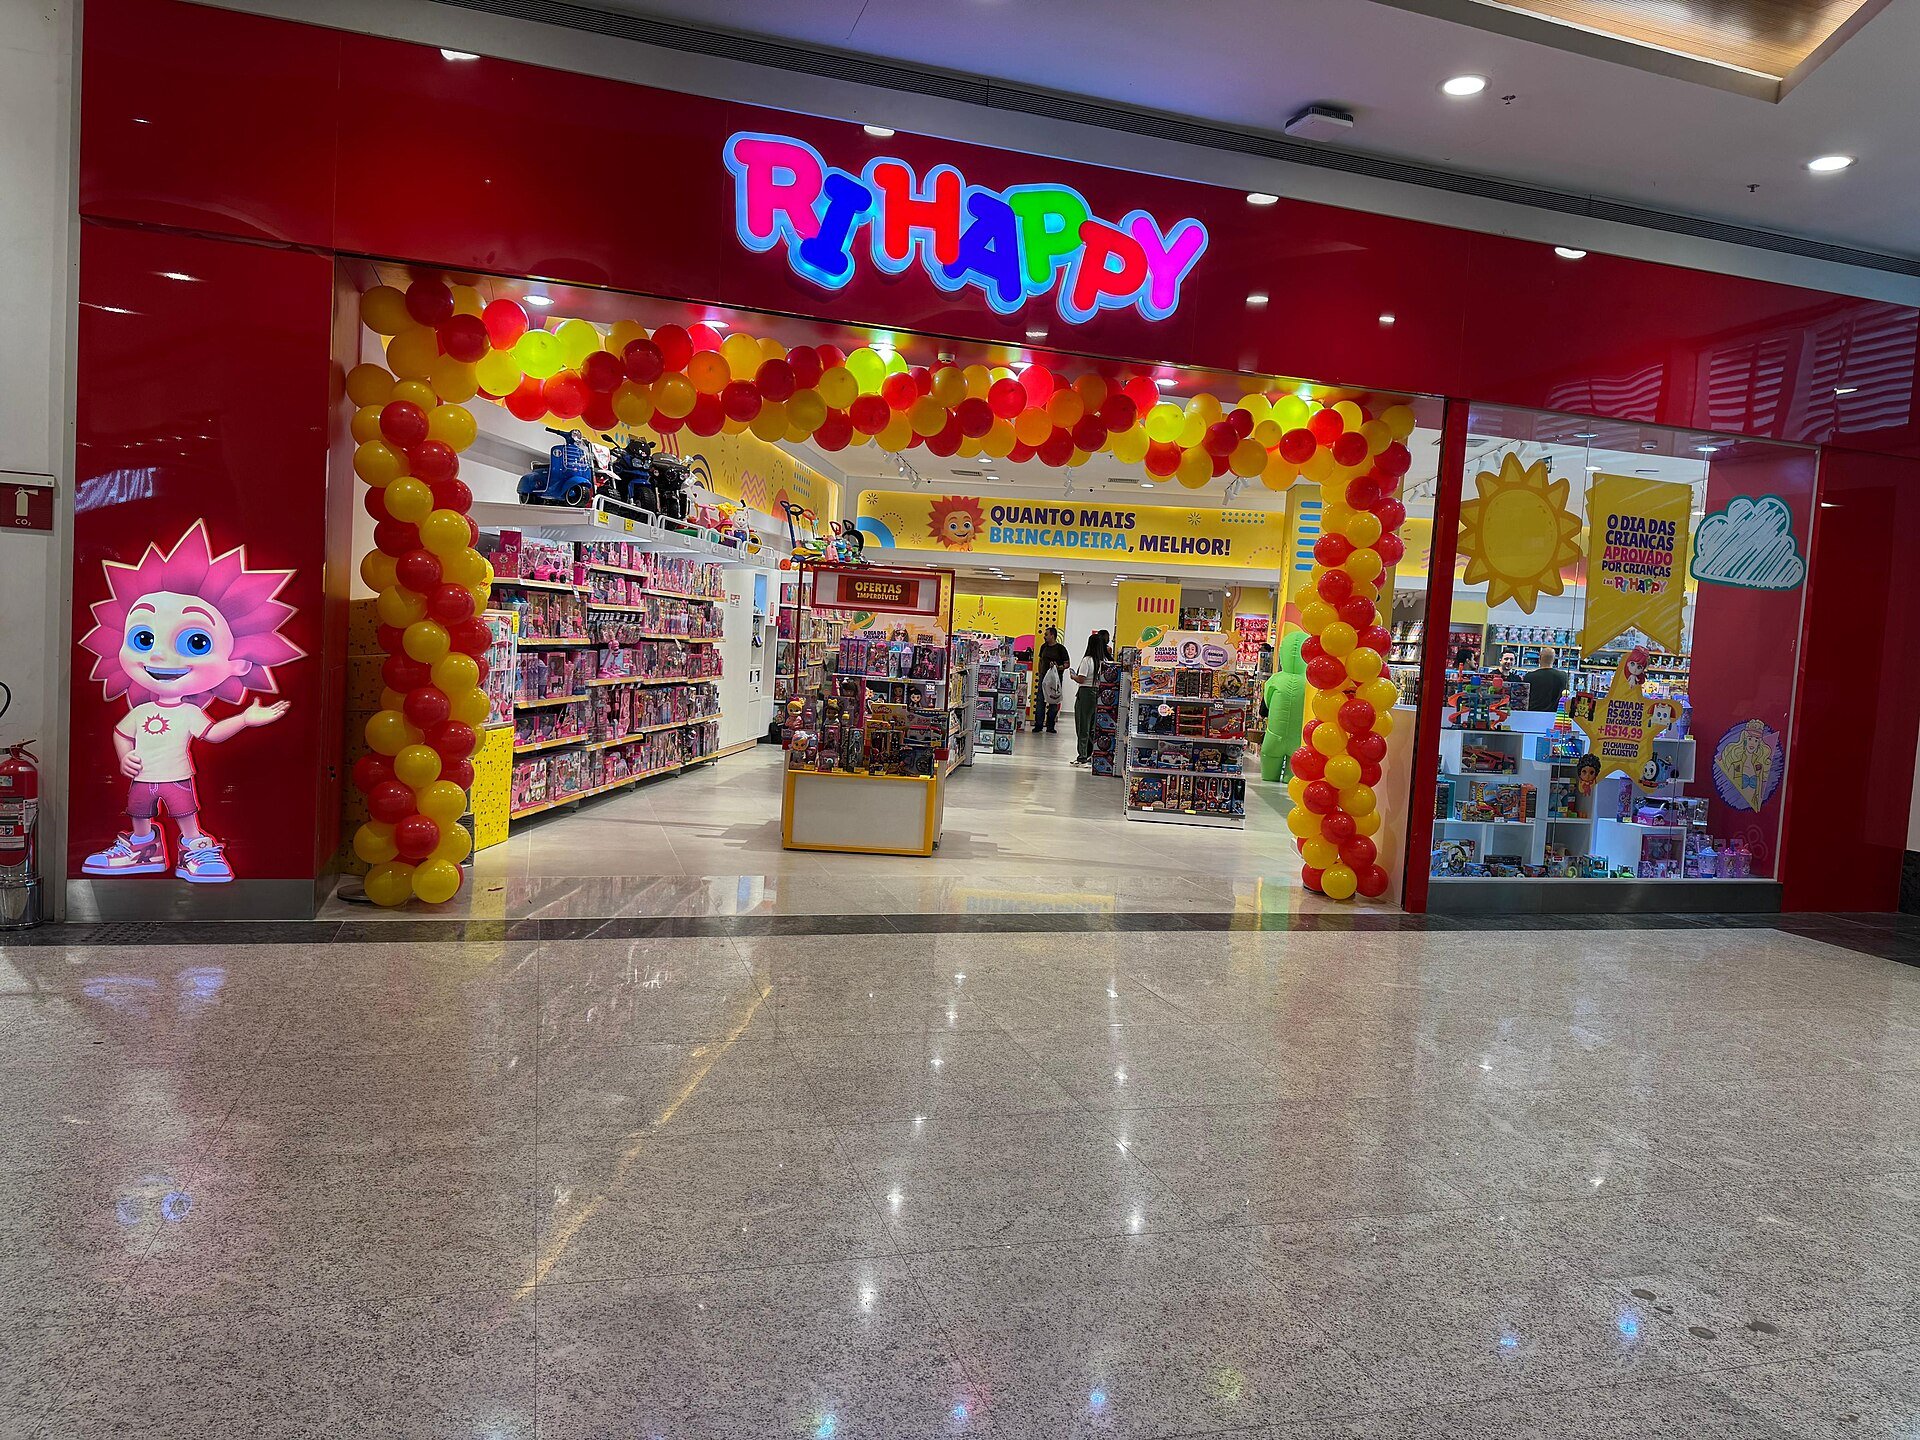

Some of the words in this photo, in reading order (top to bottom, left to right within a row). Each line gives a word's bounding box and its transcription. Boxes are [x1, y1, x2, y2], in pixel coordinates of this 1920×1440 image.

[990, 505, 1075, 527] QUANTO
[1079, 509, 1136, 529] MAIS
[1607, 514, 1619, 529] O
[1620, 515, 1646, 533] DIA
[1648, 518, 1676, 536] DAS
[989, 526, 1135, 553] BRINCADEIRA,
[1138, 534, 1231, 556] MELHOR!
[1605, 529, 1675, 552] CRIANÇAS
[1603, 545, 1673, 566] APROVADO
[1601, 560, 1622, 572] POR
[1623, 562, 1672, 578] CRIANÇAS
[855, 581, 902, 594] OFERTAS
[857, 592, 899, 601] IMPERDÍVEIS
[1608, 700, 1634, 710] ACIMA
[1635, 702, 1645, 711] DE
[1605, 717, 1615, 725] EM
[1615, 718, 1643, 727] COMPRAS
[1601, 747, 1638, 758] EXCLUSIVO
[1610, 741, 1639, 750] CHAVEIRO
